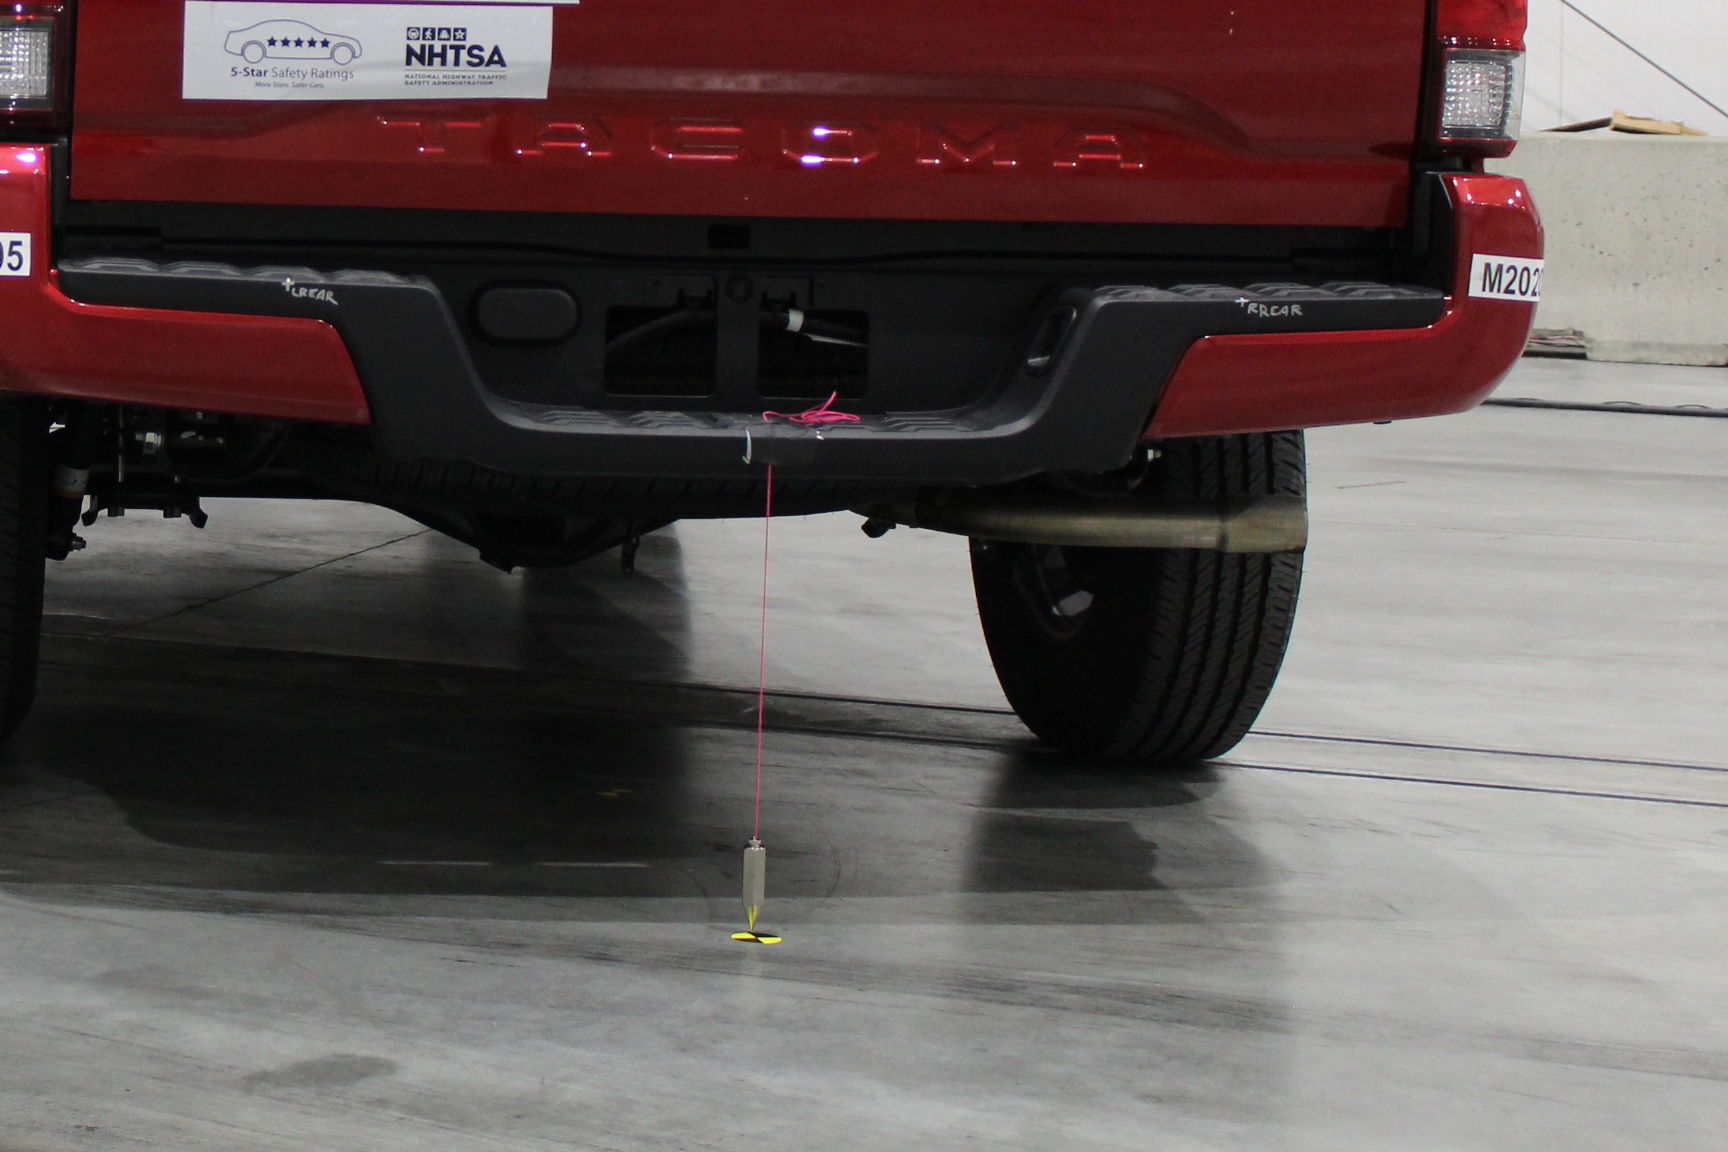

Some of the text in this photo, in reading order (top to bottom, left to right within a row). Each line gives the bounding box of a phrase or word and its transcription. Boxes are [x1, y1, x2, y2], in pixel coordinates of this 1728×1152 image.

[405, 43, 507, 68] NHTSA
[230, 66, 355, 81] 5-Star Safety Ratings
[1481, 262, 1543, 297] M202
